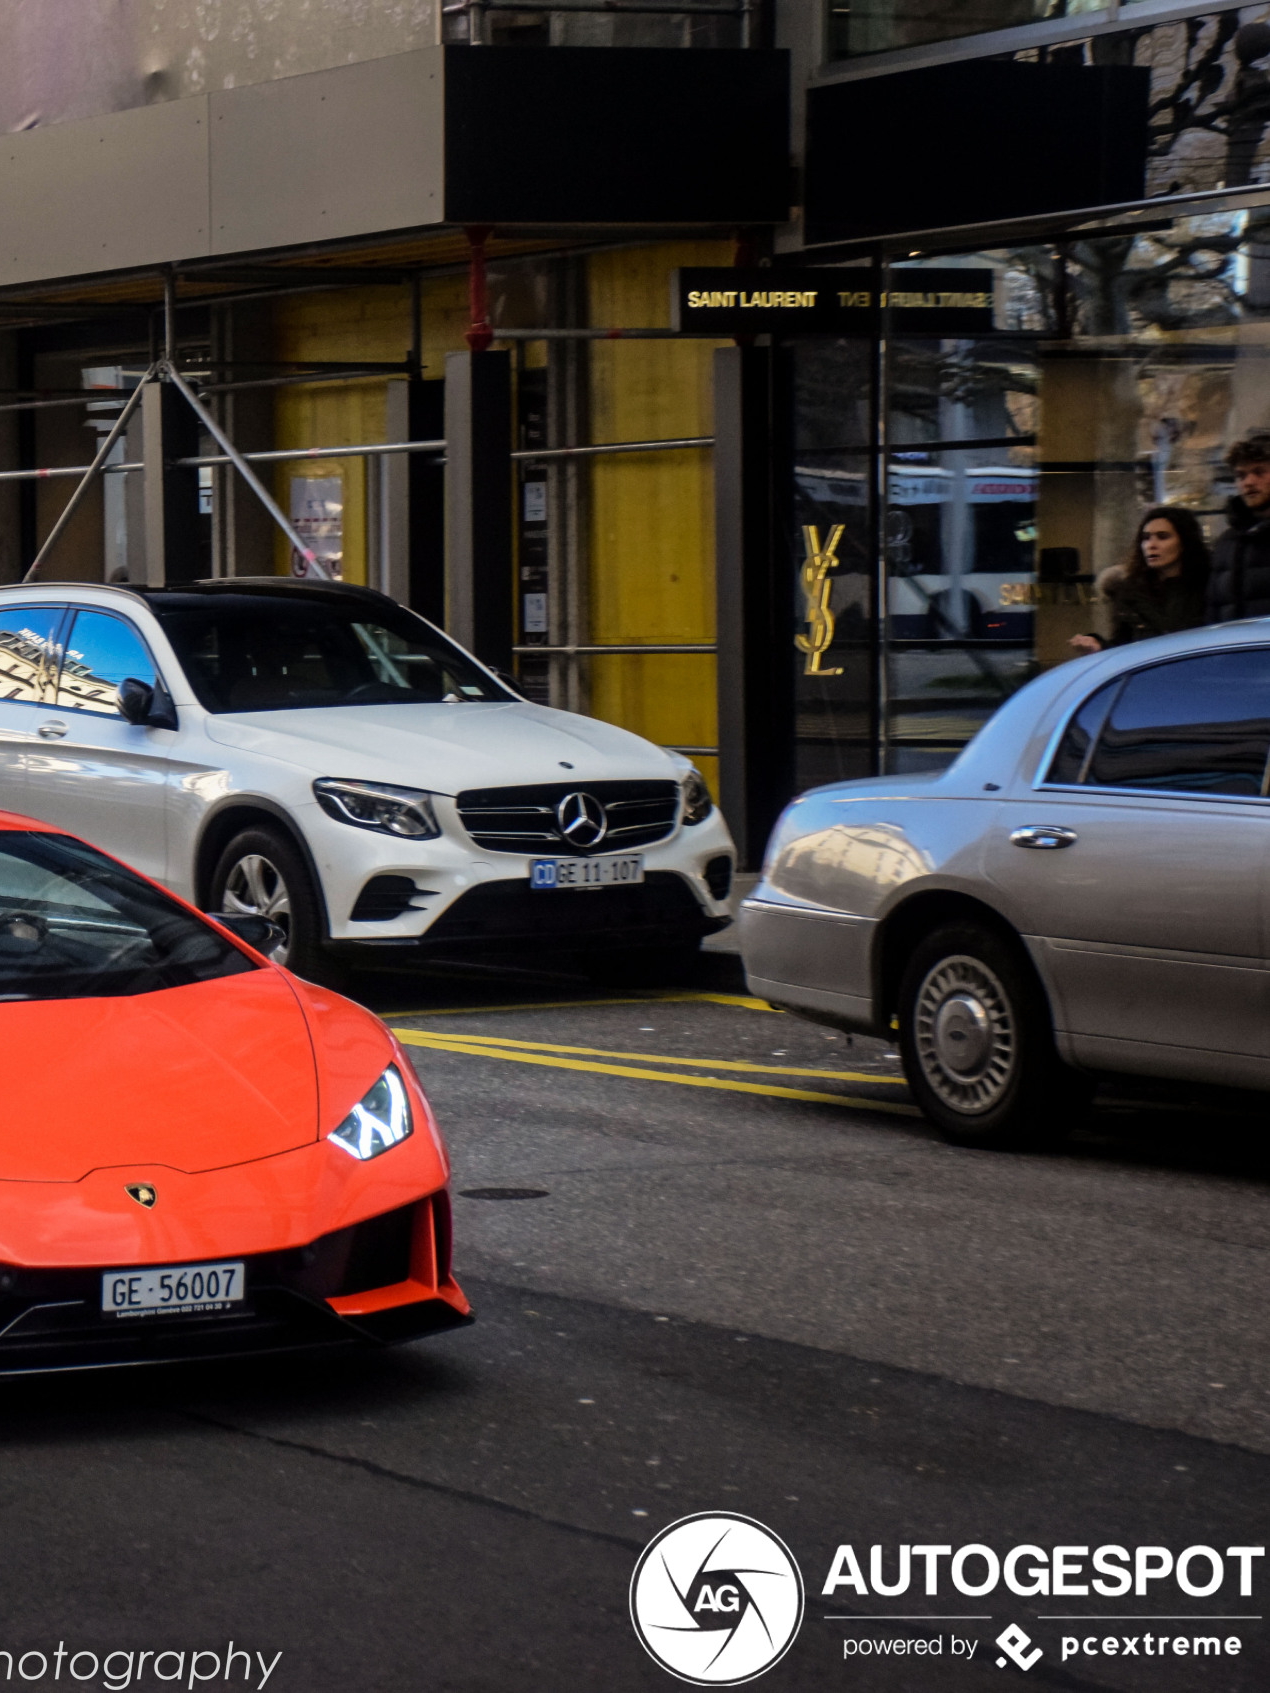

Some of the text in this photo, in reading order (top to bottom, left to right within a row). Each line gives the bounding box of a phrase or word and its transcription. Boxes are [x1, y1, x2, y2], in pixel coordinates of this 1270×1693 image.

[687, 291, 818, 307] SAINT LAURENT
[534, 864, 556, 885] CD
[557, 863, 577, 883] GE
[112, 1277, 142, 1307] GE
[159, 1269, 236, 1302] 56007
